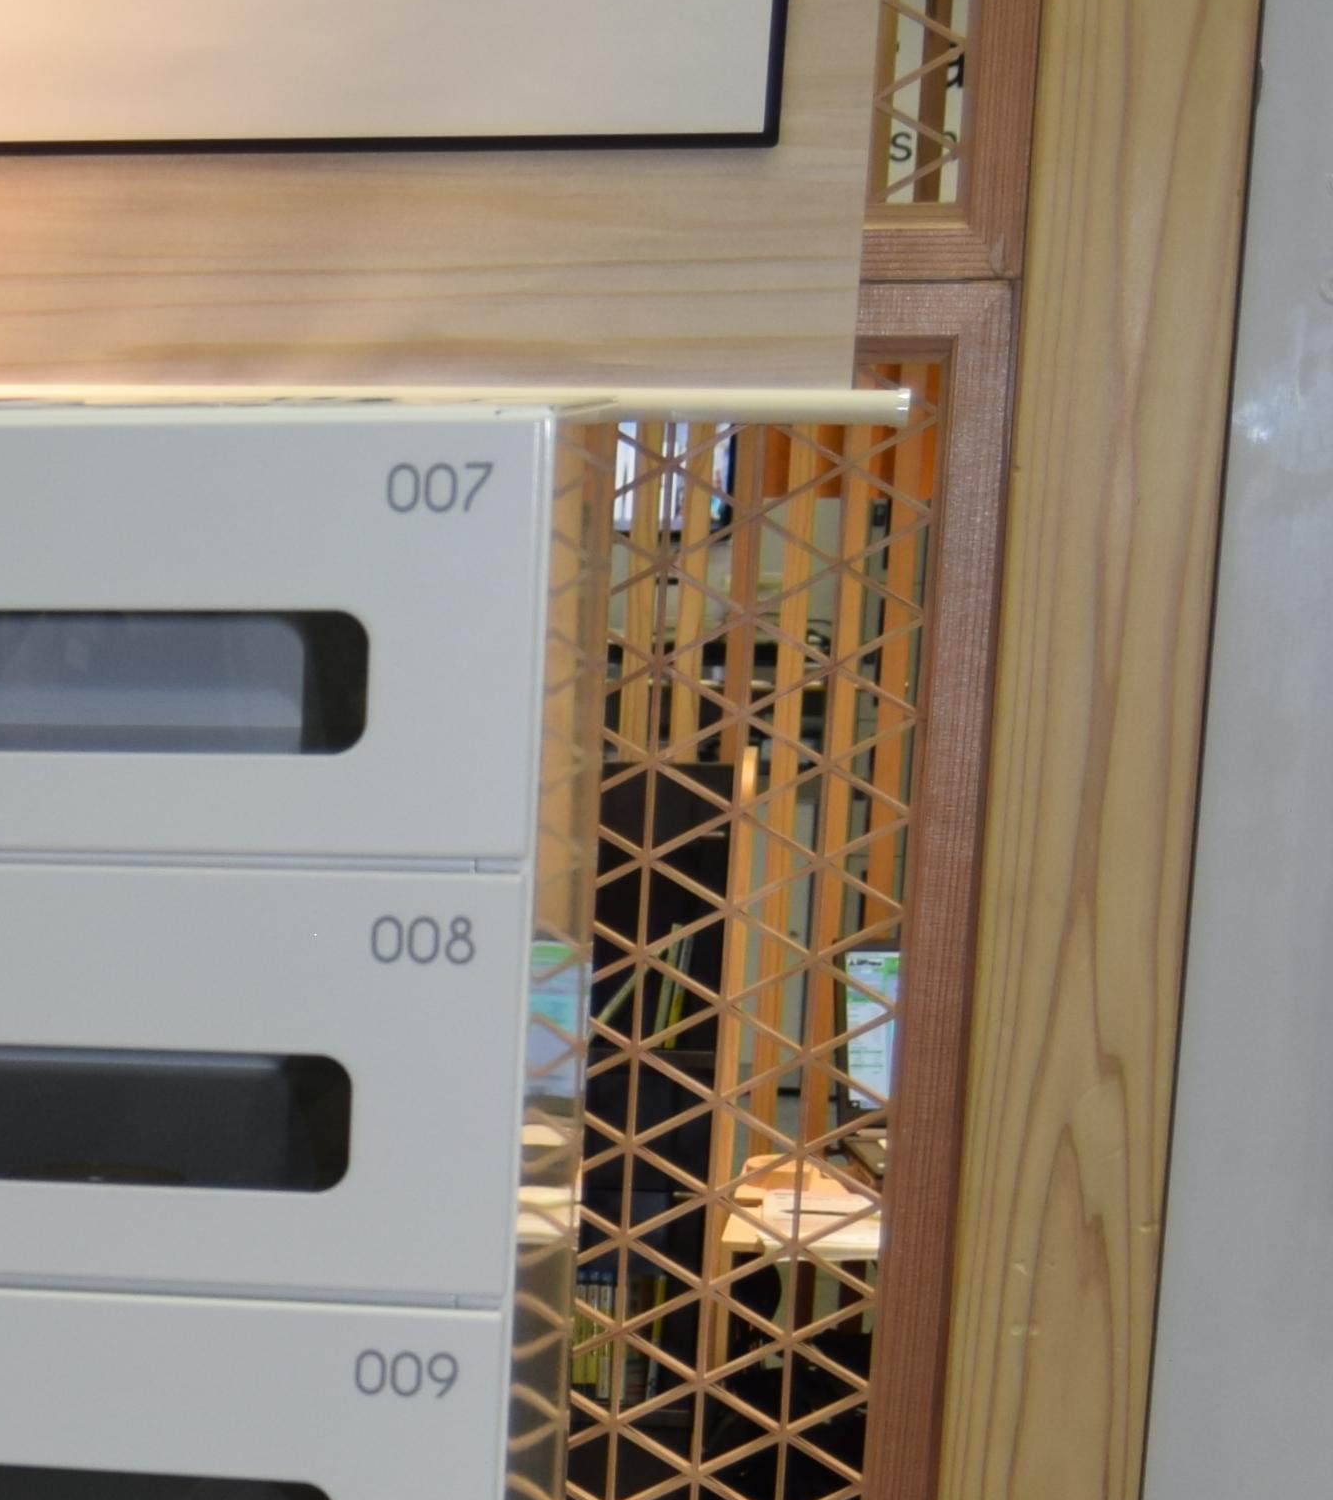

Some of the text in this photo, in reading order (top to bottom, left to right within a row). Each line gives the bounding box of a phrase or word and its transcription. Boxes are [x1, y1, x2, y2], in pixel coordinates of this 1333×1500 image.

[386, 461, 494, 514] 007
[370, 914, 476, 966] 008
[354, 1348, 459, 1399] 009
